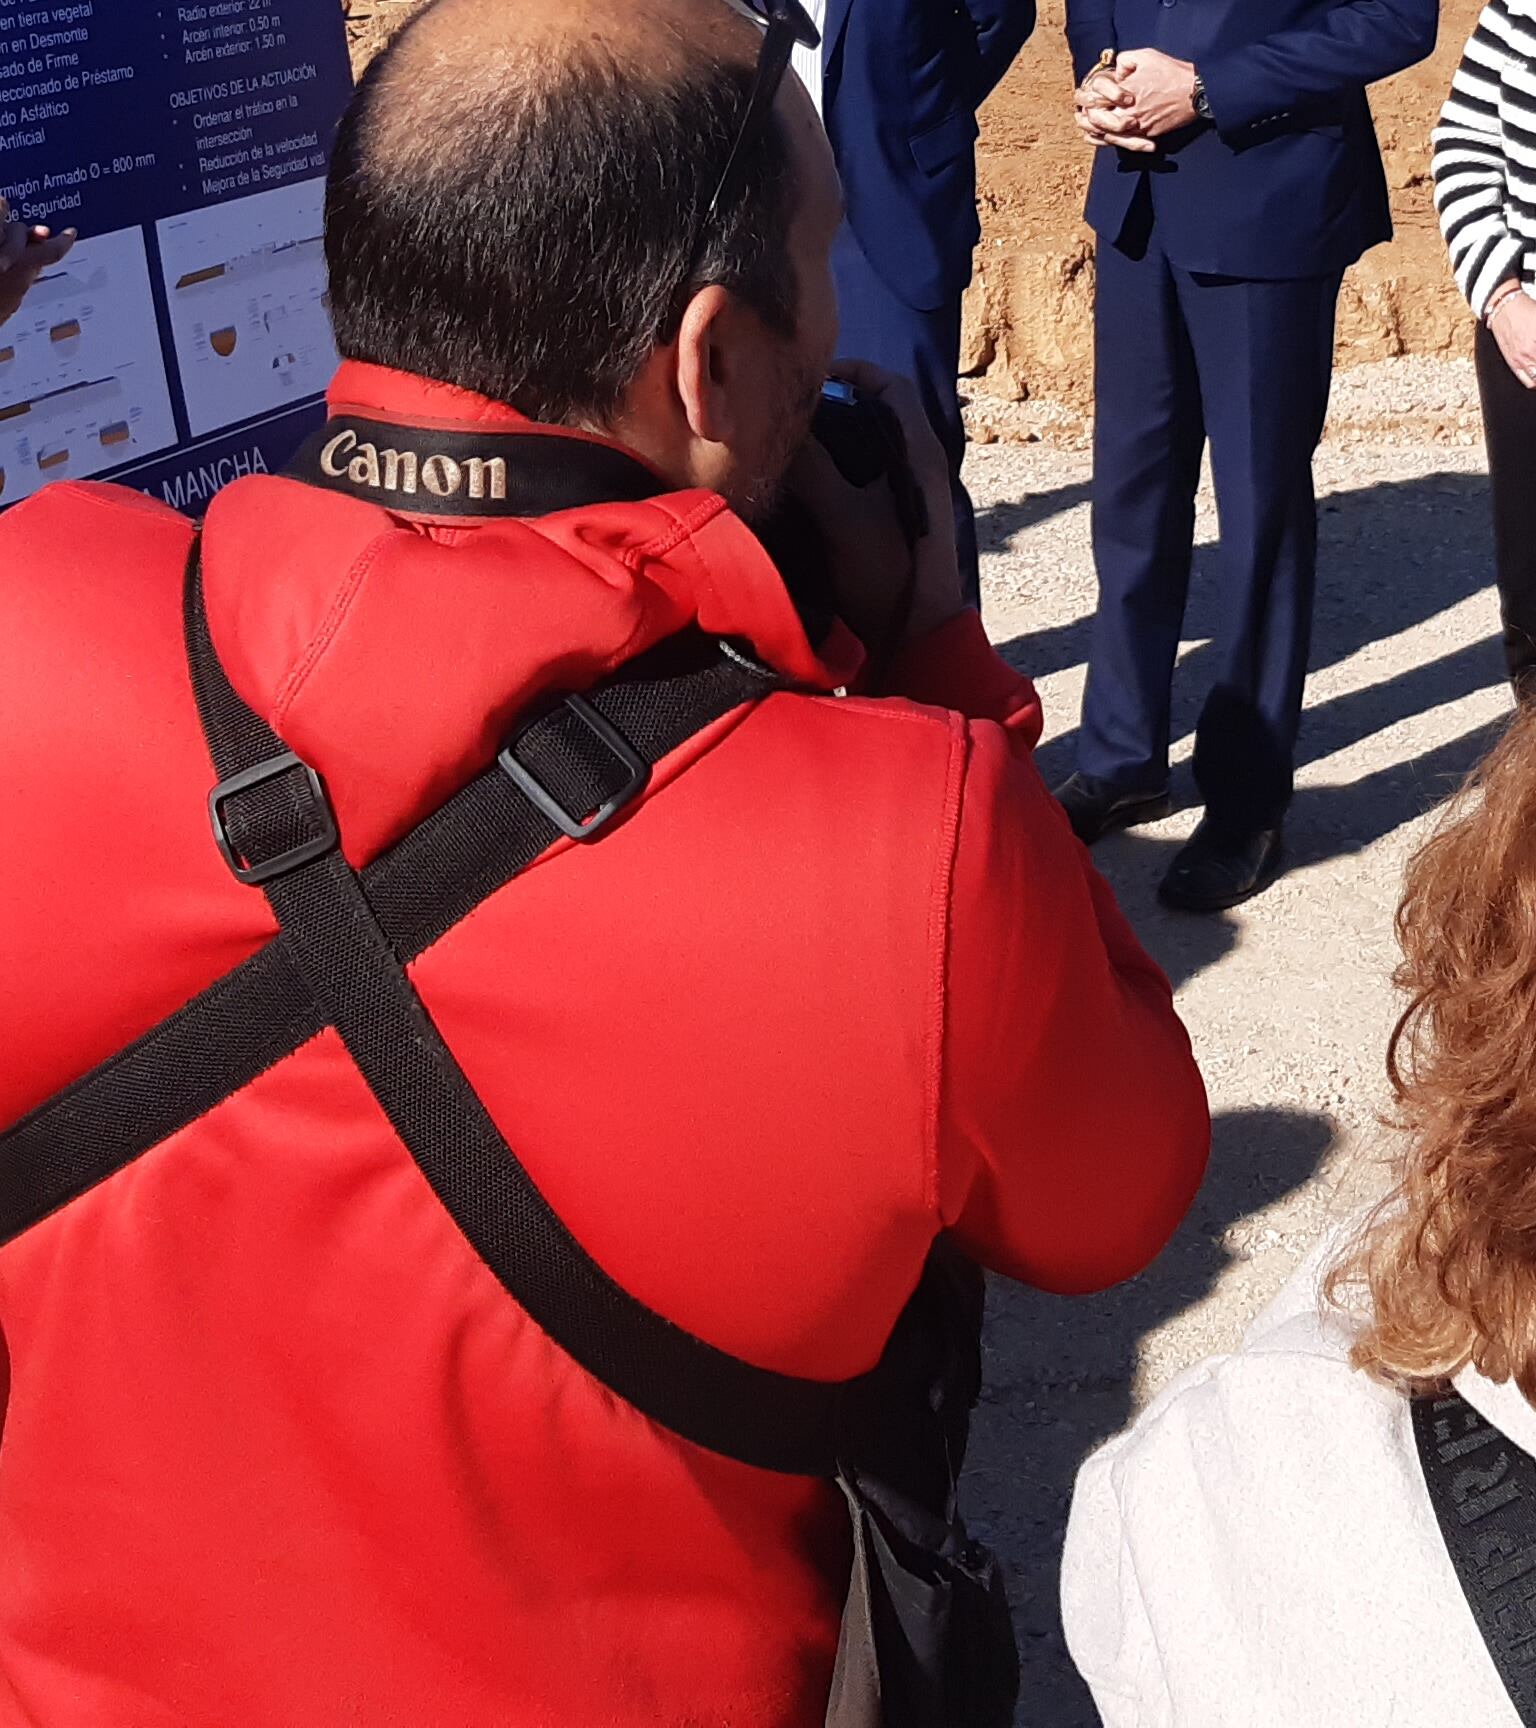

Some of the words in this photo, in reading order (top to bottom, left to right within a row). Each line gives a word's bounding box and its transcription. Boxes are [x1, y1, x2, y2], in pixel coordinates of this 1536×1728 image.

[0, 17, 15, 30] en
[18, 11, 49, 27] tierra
[51, 0, 93, 23] vegetal
[178, 5, 207, 22] Radio
[11, 39, 27, 53] en
[29, 28, 88, 49] Desmonte
[183, 27, 211, 44] Arcén
[271, 16, 280, 27] m
[27, 57, 43, 73] de
[45, 53, 79, 69] Firme
[185, 46, 214, 64] Arcén
[276, 34, 286, 45] m
[64, 74, 79, 90] de
[81, 66, 134, 86] Préstamo
[170, 83, 228, 108] OBJETIVOS
[230, 79, 245, 95] DE
[245, 77, 259, 91] LA
[261, 63, 317, 88] ACTUACIÓN
[20, 101, 69, 123] Asfáltico
[193, 110, 232, 129] Ordenar
[235, 105, 244, 120] el
[245, 101, 274, 118] tráfico
[275, 98, 287, 111] en
[288, 95, 298, 107] la
[0, 127, 45, 151] Artificial
[196, 127, 253, 150] intersección
[199, 150, 249, 172] Reducción
[251, 145, 263, 160] de
[264, 143, 274, 156] la
[275, 131, 318, 153] velocidad
[44, 167, 87, 190] Armado
[112, 155, 133, 173] 800
[135, 154, 155, 167] mm
[202, 176, 236, 195] Mejora
[237, 171, 249, 186] de
[251, 168, 261, 182] la
[262, 155, 308, 179] Seguridad
[309, 151, 325, 167] vial
[22, 191, 81, 219] Seguridad
[162, 446, 268, 509] MANCHA
[320, 429, 506, 499] Canon
